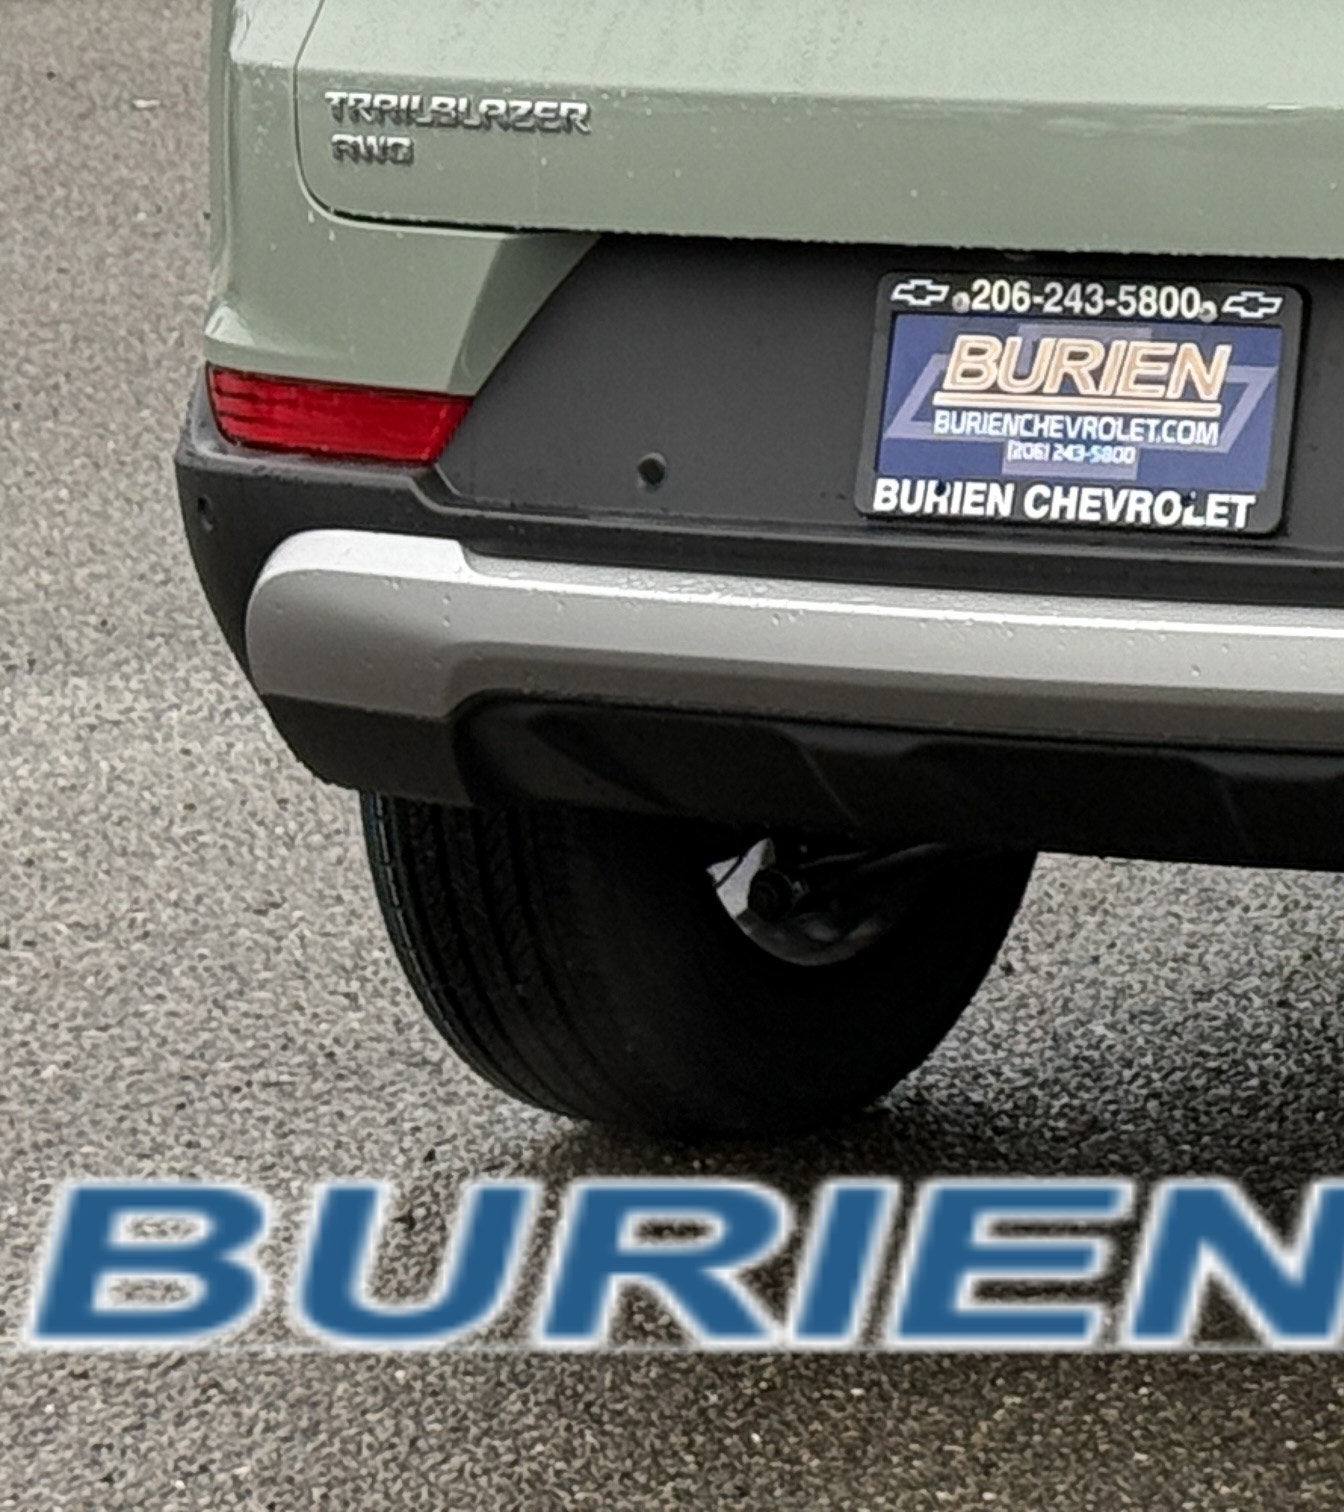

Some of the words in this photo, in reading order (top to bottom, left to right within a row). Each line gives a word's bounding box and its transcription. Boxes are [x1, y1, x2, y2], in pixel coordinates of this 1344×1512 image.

[324, 91, 593, 133] TRAILBLAZER
[331, 134, 414, 165] AWD
[971, 279, 1202, 320] 206-243-5800
[942, 334, 1233, 400] BURIEN
[933, 408, 1220, 446] BURIENCHEVROLET.COM
[1052, 443, 1137, 464] 243-5800
[872, 478, 1014, 518] BURIEN
[1024, 484, 1257, 530] CHEVROLET
